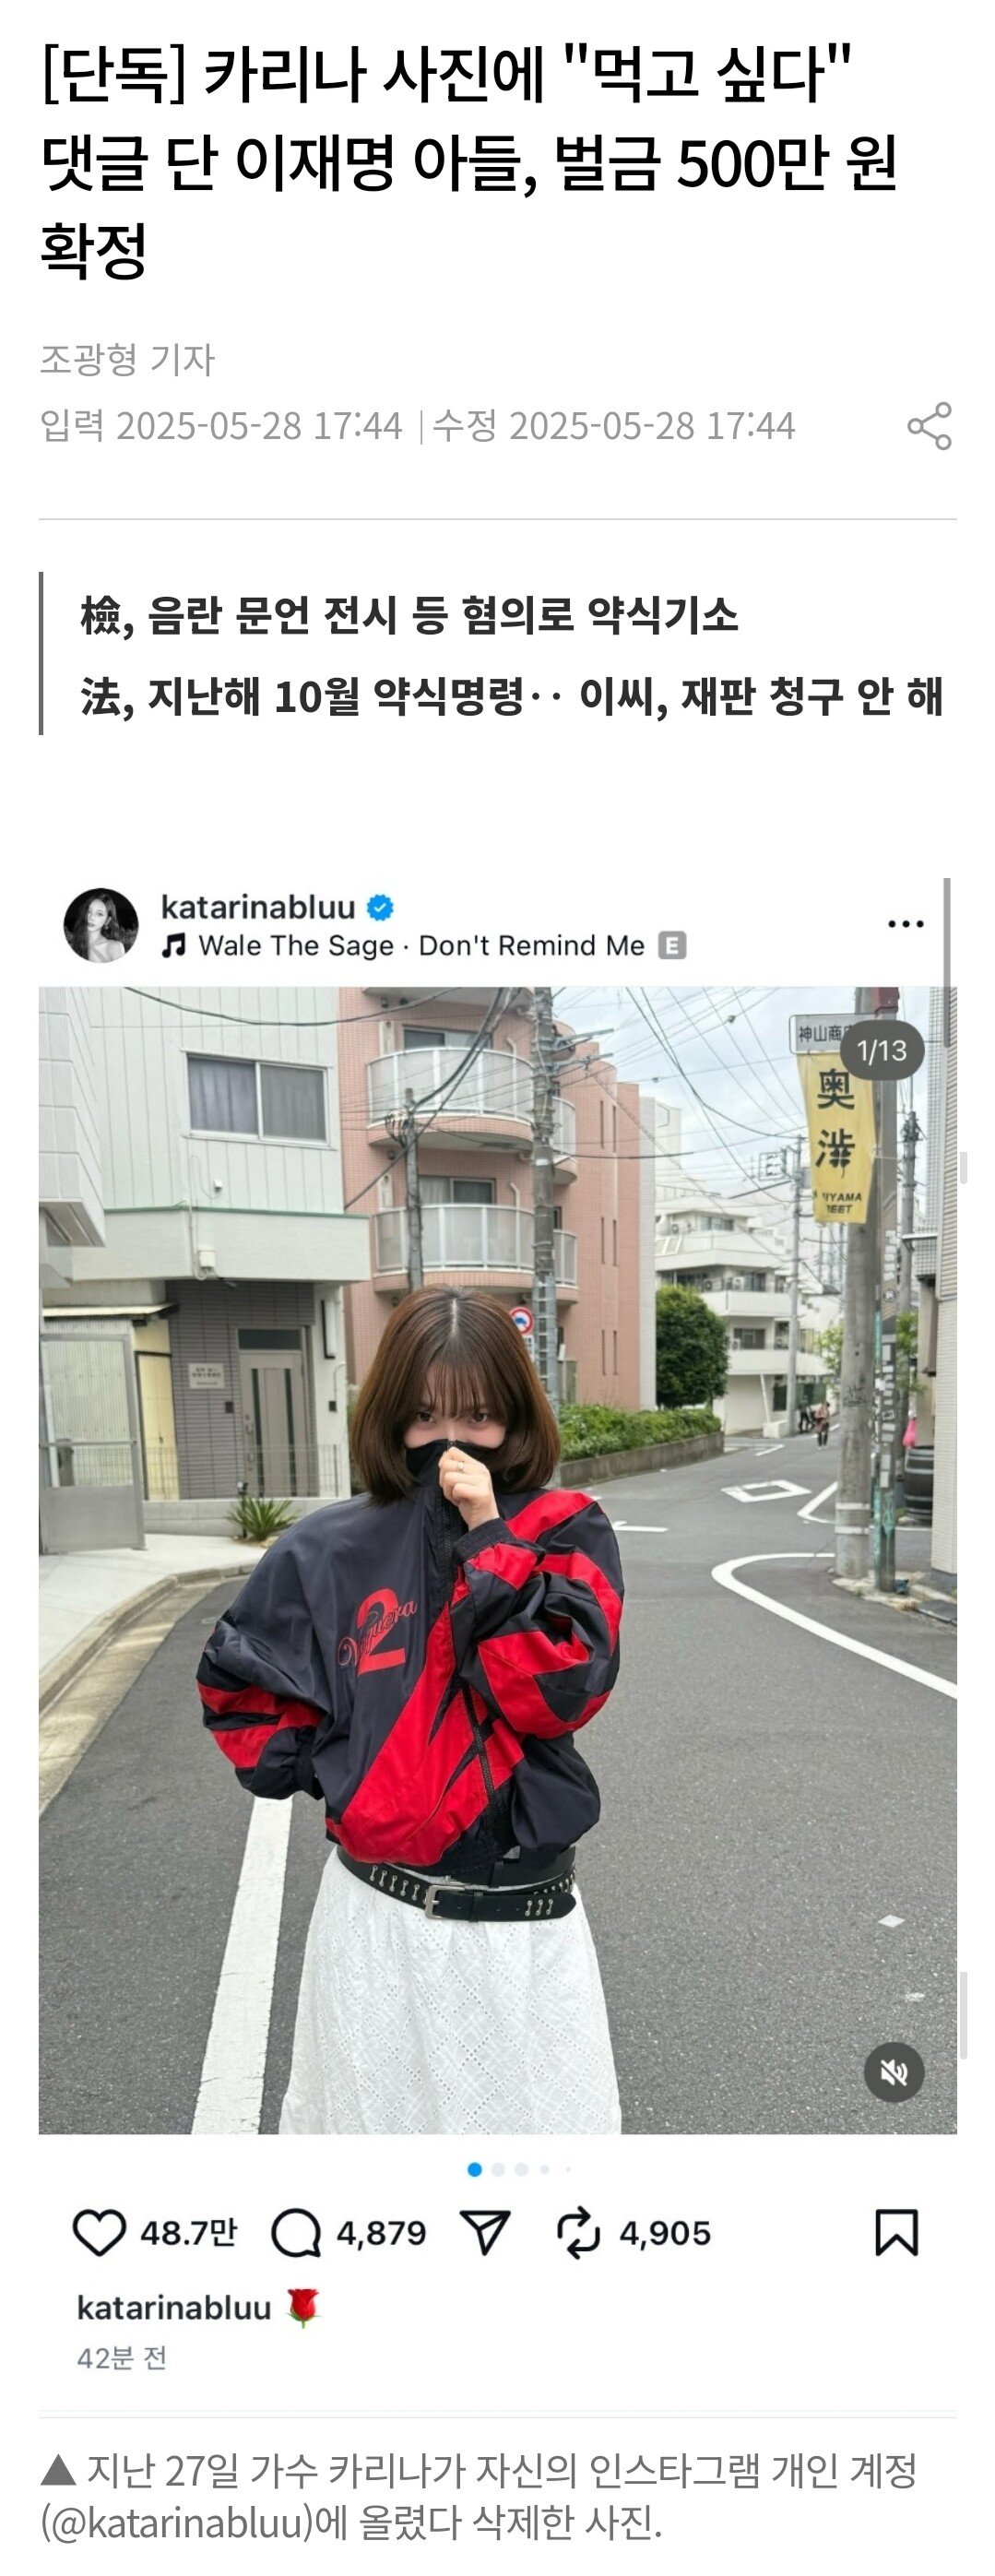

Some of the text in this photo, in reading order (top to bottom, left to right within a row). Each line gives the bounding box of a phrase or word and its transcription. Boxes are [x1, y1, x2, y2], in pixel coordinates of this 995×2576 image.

[45, 42, 850, 104] [단독] 카리나 사진에 "먹고 싶다"
[44, 134, 895, 198] 댓글 단 이재명 아들, 벌금 500만 원
[41, 222, 144, 280] 확정
[41, 343, 215, 376] 조광형 기자
[41, 410, 795, 442] 입력 2025-05-28 17:44 수정 2025-05-28 17:44
[80, 595, 739, 640] 檢, 음란 문언 전시 등 혐의로 약식기소
[81, 677, 134, 721] 法,
[148, 677, 258, 716] 지난해
[277, 677, 359, 716] 10월
[581, 677, 667, 722] 이씨,
[681, 677, 756, 716] 재판
[770, 677, 844, 716] 청구
[858, 677, 894, 716] 안
[907, 677, 942, 716] 해
[162, 894, 354, 920] katarinabluu
[199, 934, 261, 956] Wale
[270, 934, 319, 956] The
[329, 934, 394, 961] Sage
[421, 934, 489, 956] Don't
[500, 934, 595, 956] Remind
[608, 934, 645, 956] Me
[357, 1588, 406, 1676] 2
[141, 2217, 238, 2247] 48.7만
[337, 2220, 426, 2251] 4,879
[620, 2220, 711, 2251] 4,905
[78, 2294, 270, 2321] katarinabluu
[77, 2345, 165, 2369] 42분 전
[88, 2453, 915, 2489] 지난 27일 가수 카리나가 자신의 인스타그램 개인 계정
[42, 2503, 661, 2544] (@katarinabluu)에 올렸다 삭제한 사진.
